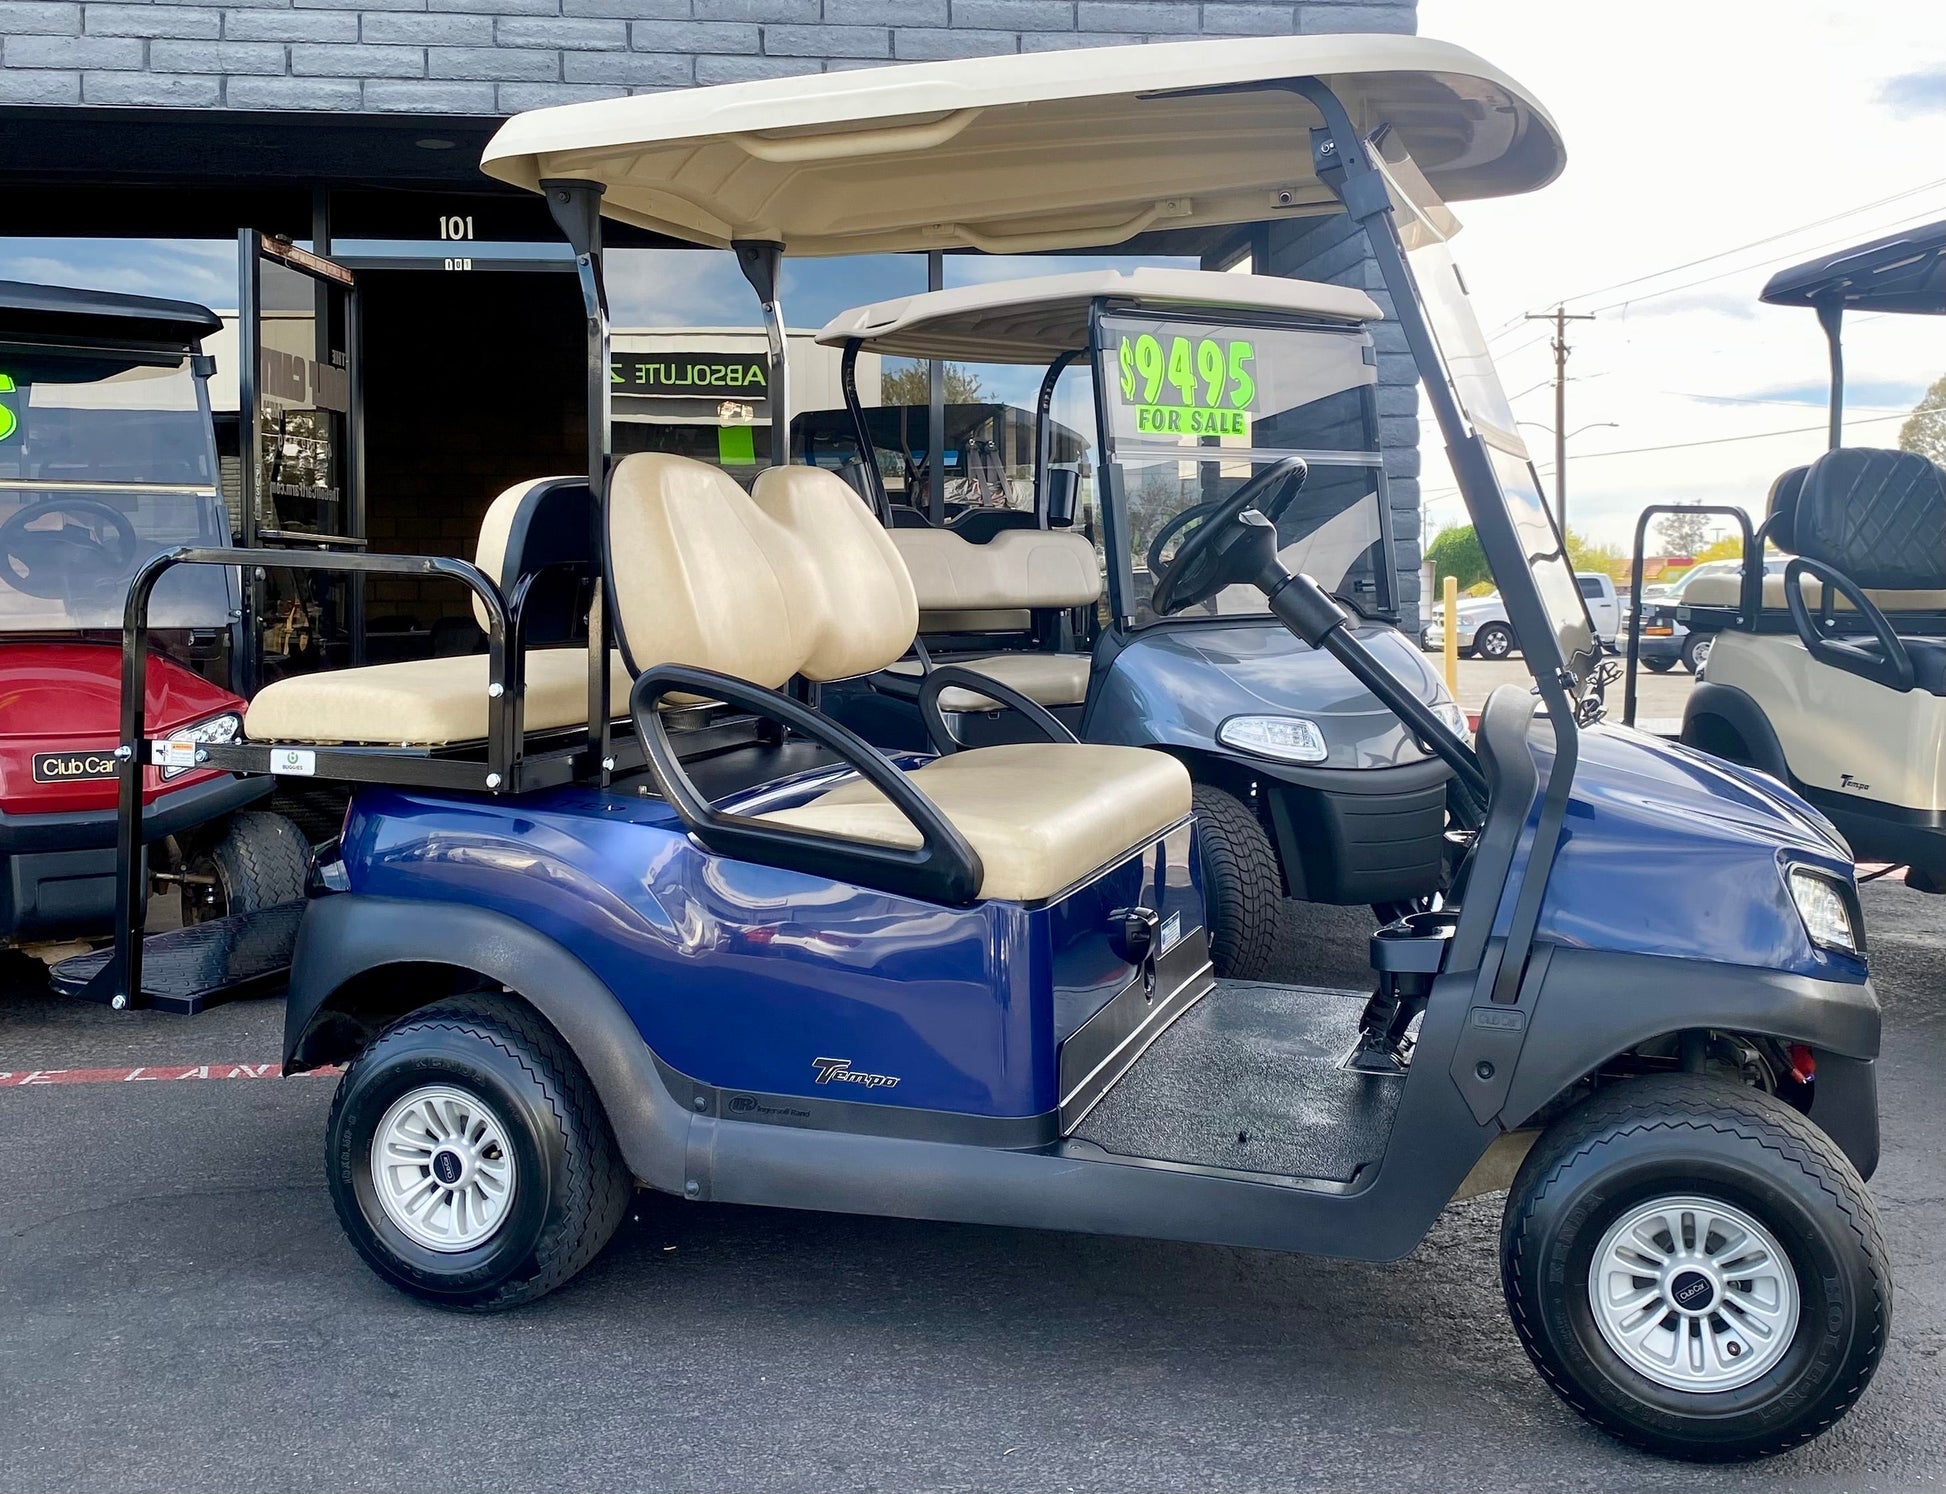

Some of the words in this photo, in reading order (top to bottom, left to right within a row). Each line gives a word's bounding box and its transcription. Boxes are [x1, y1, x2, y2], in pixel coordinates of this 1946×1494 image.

[440, 216, 473, 240] 101
[445, 259, 472, 270] 101
[1119, 334, 1255, 410] $9495
[1138, 408, 1181, 432] FOR
[1191, 410, 1244, 434] SALE
[1840, 773, 1870, 791] Tempo
[124, 1064, 311, 1081] LAN
[812, 1057, 900, 1088] Tempo
